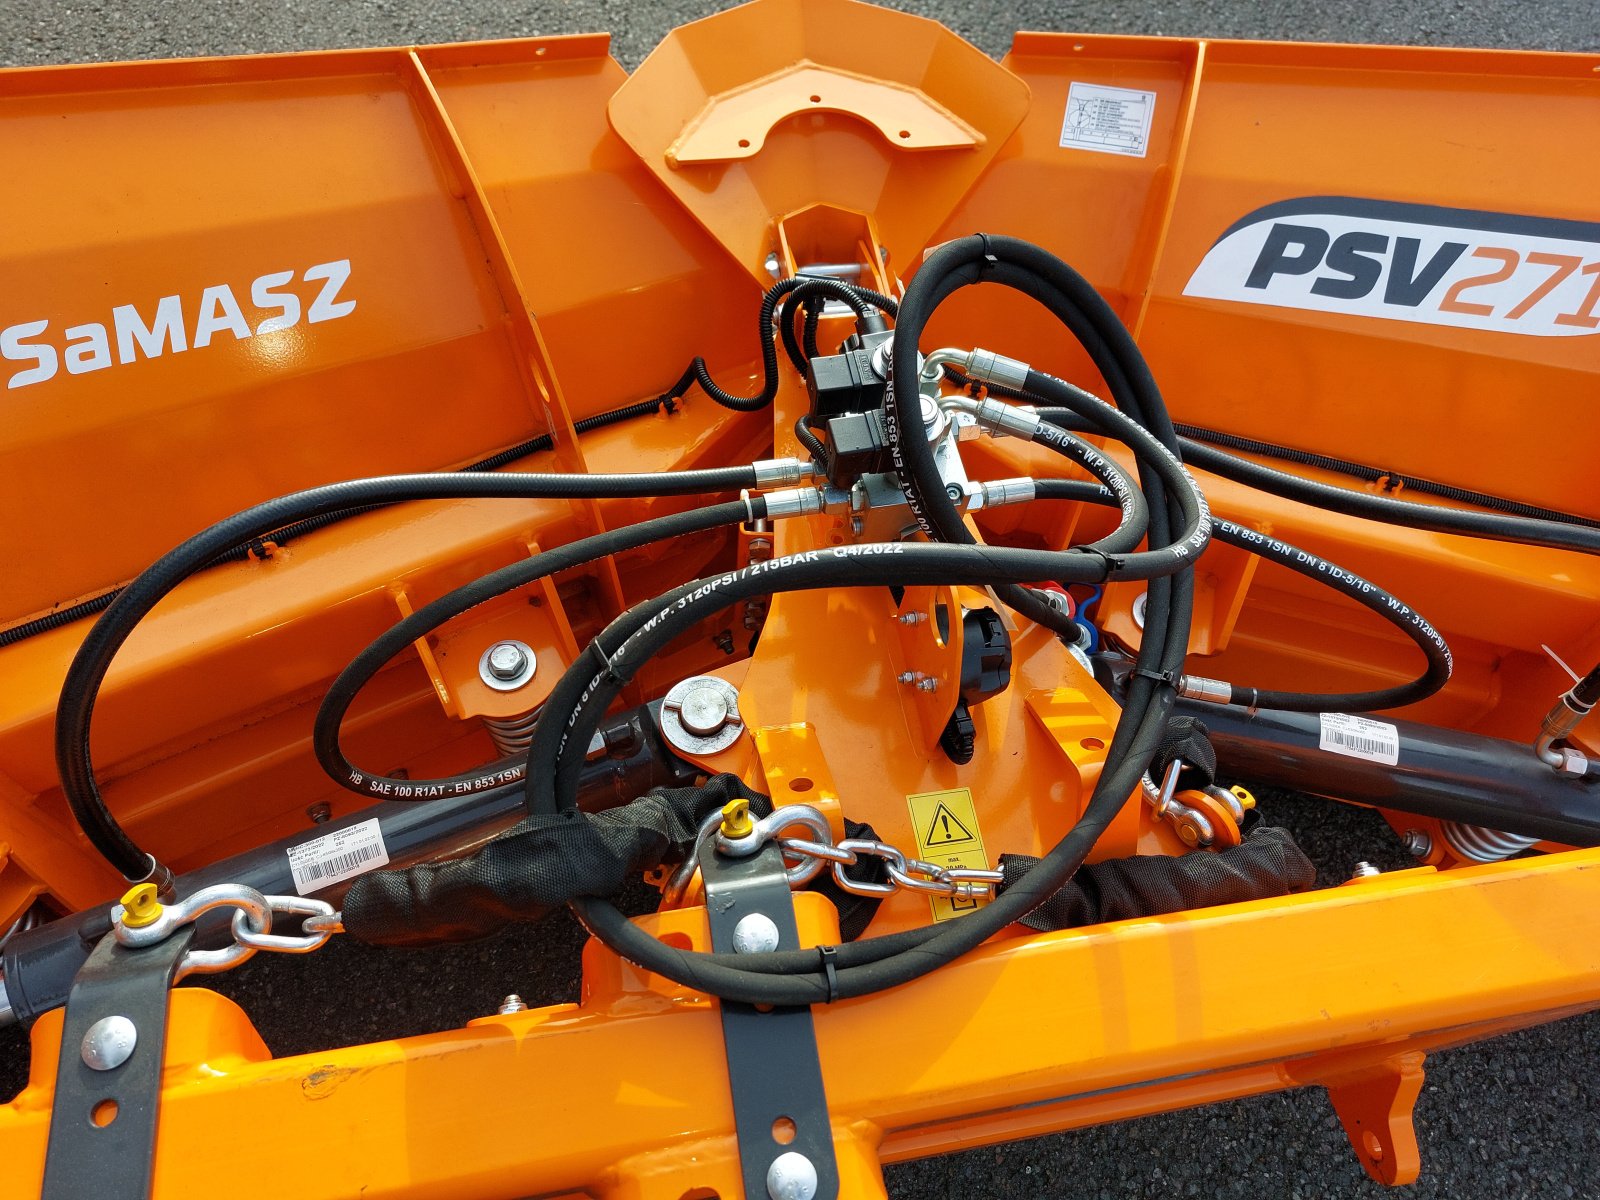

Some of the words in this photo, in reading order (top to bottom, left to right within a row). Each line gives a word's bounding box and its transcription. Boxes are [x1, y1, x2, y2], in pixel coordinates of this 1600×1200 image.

[0, 259, 356, 389] SaMASZ
[885, 381, 896, 414] 1SN
[887, 415, 898, 444] 853
[892, 447, 903, 468] EN
[1034, 423, 1077, 448] D-5/16"
[1083, 449, 1104, 473] W.P.
[1171, 544, 1189, 558] HB
[1189, 530, 1207, 548] SAE
[643, 609, 675, 632] W.P.
[677, 573, 738, 609] 3120PSI
[750, 550, 819, 576] 215BAR
[833, 542, 904, 558] Q4/2022
[1220, 522, 1239, 536] EN
[1241, 529, 1263, 544] 853
[1266, 539, 1292, 556] 1SN
[1296, 551, 1318, 567] DN
[1318, 561, 1326, 571] 8
[1387, 596, 1410, 620] W.P.
[349, 770, 363, 785] HB
[369, 781, 391, 795] SAE
[394, 786, 412, 797] 100
[415, 785, 445, 797] R1AT
[455, 781, 472, 793] EN
[475, 776, 495, 789] 853
[497, 768, 521, 783] 1SN
